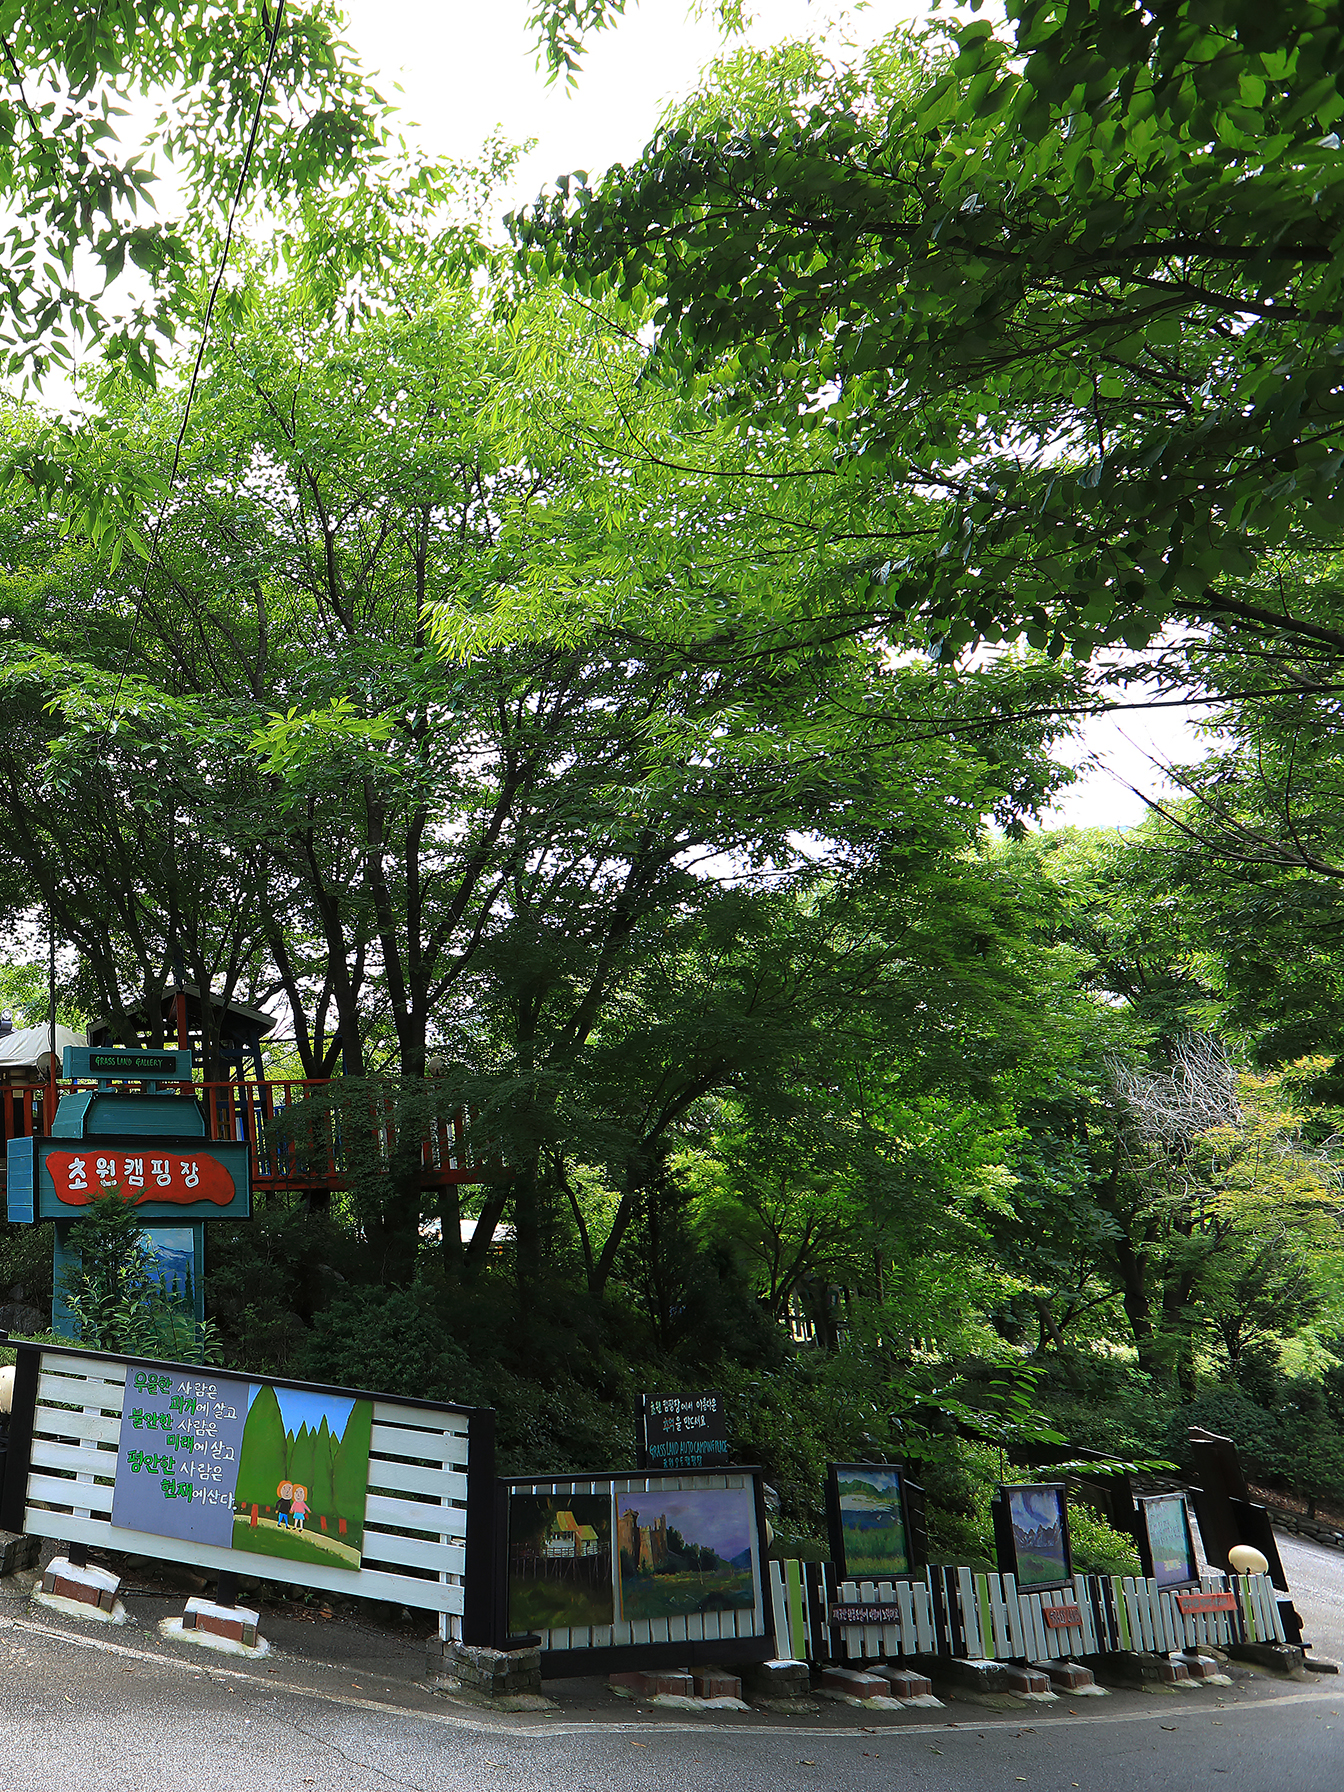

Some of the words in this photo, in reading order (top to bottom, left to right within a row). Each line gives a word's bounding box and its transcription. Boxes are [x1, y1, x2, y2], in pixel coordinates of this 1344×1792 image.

[95, 1056, 116, 1066] GRASS
[135, 1058, 163, 1069] GALLERY
[68, 1157, 199, 1190] 초원캠핑장
[133, 1371, 173, 1395] 우울한
[177, 1381, 218, 1400] 사람은
[128, 1407, 173, 1431] 불안한
[177, 1418, 218, 1437] 사람은
[169, 1395, 210, 1418] 과거에
[212, 1402, 238, 1420] 살고
[166, 1434, 208, 1455] 미래에
[210, 1440, 235, 1461] 살고
[126, 1449, 175, 1475] 평안한
[179, 1460, 223, 1482] 사람은
